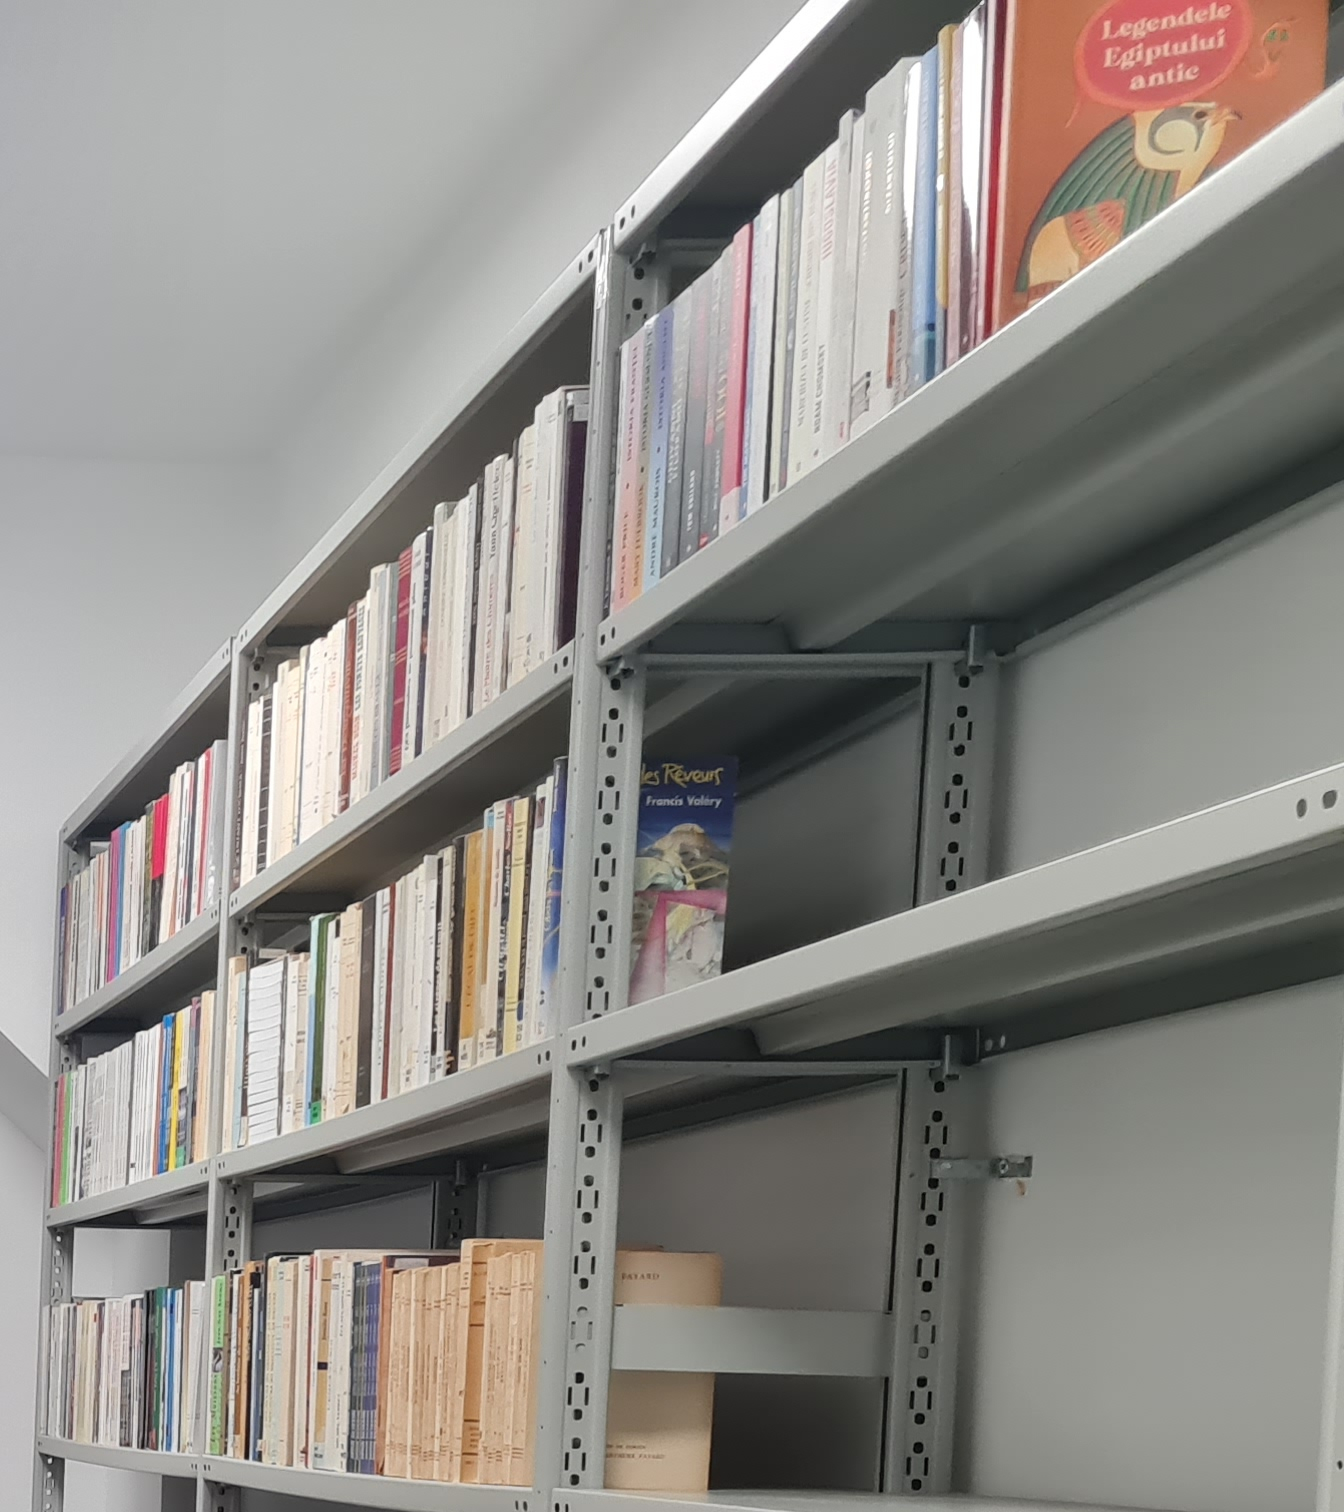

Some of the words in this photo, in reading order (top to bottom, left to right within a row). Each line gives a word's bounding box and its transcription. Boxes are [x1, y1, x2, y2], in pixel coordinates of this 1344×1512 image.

[1102, 3, 1232, 41] Legendele
[1103, 29, 1227, 69] Egiptului
[1129, 65, 1200, 91] antic
[821, 159, 838, 261] IUGOSLAVIA
[816, 344, 825, 398] CHOMSKY
[645, 796, 684, 807] Francis
[687, 795, 722, 809] Valéry
